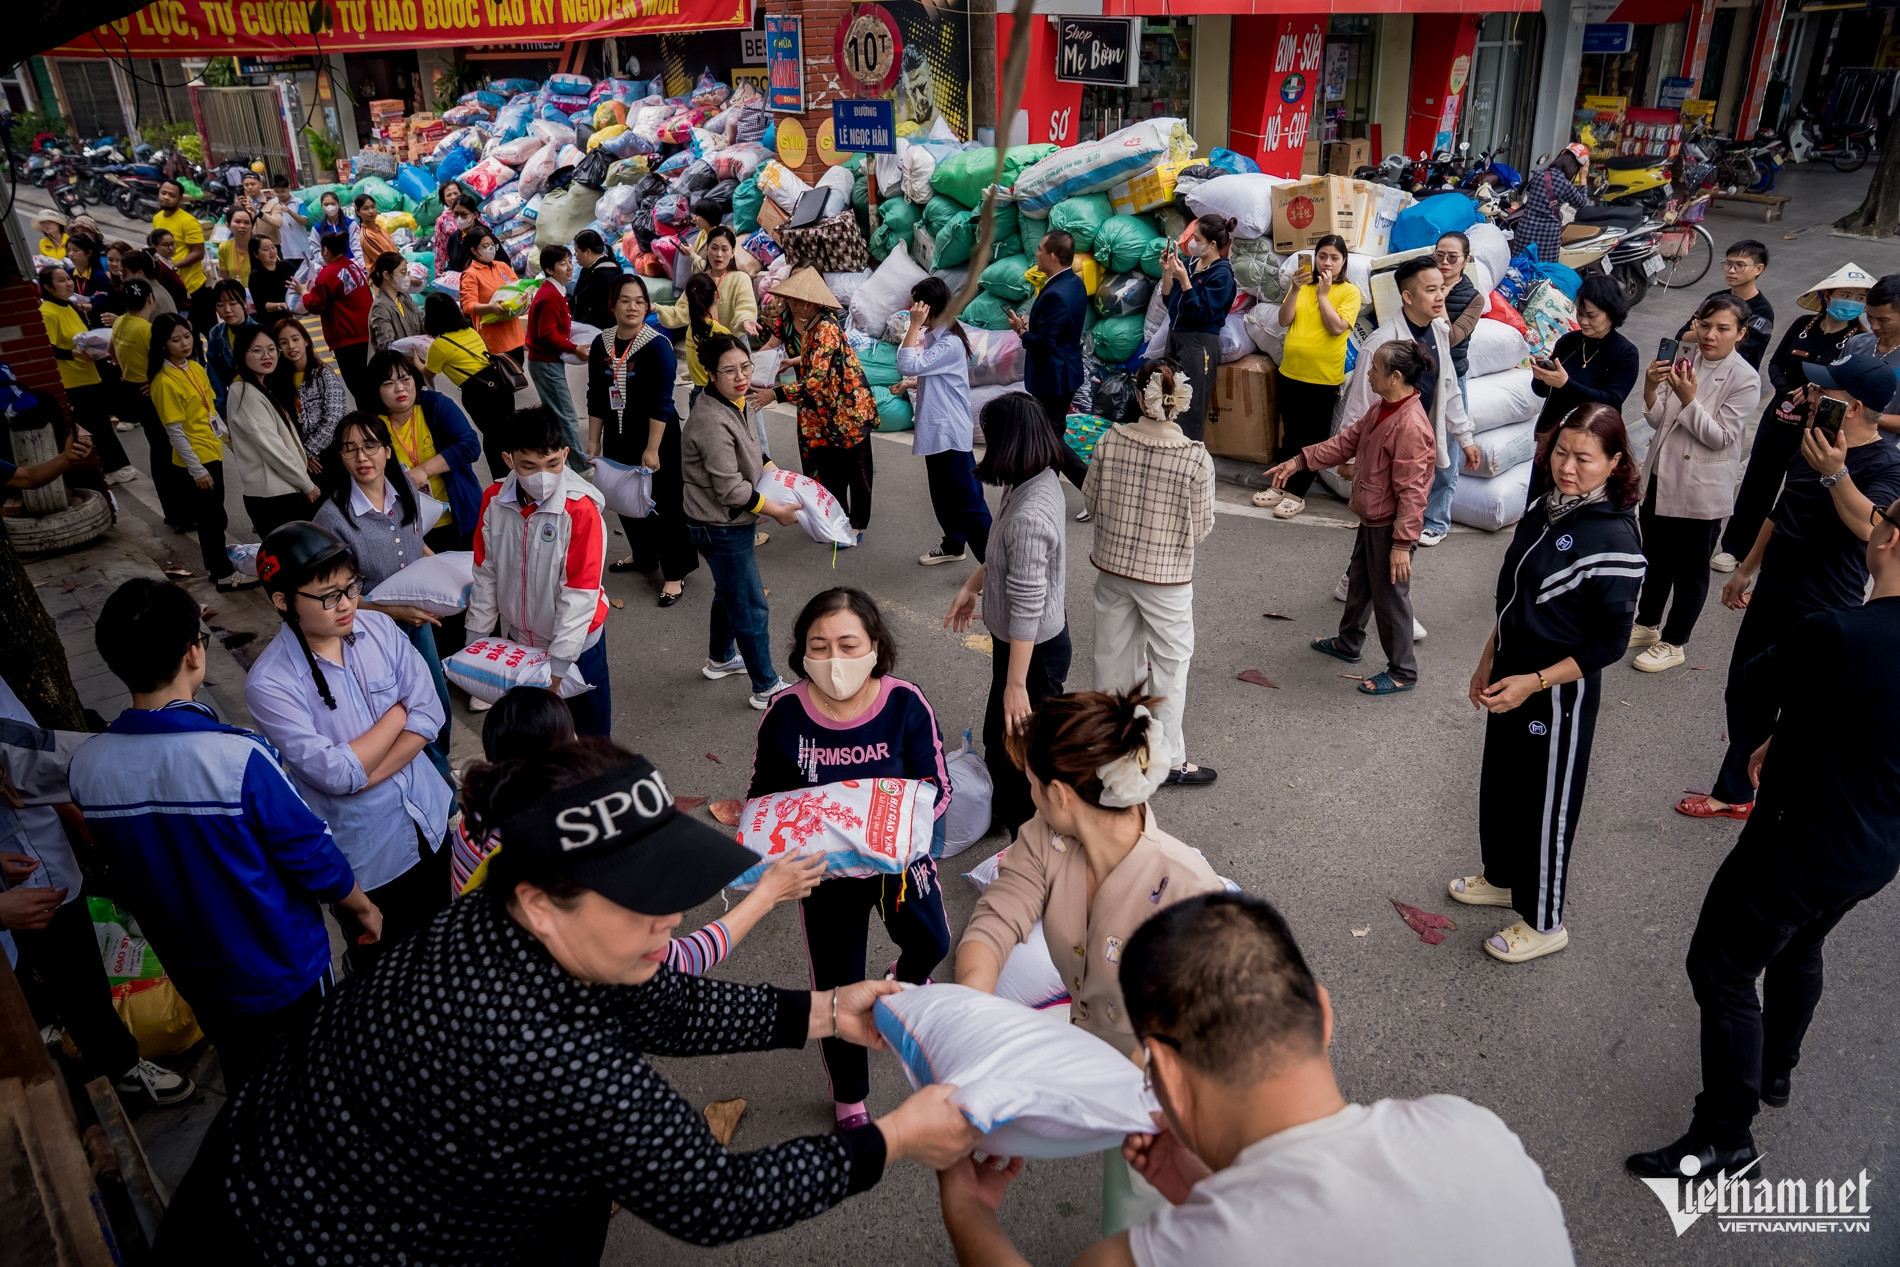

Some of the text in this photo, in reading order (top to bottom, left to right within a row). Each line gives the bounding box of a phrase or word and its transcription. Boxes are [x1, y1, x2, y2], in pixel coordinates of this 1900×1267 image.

[1065, 24, 1092, 44] Shop
[1064, 40, 1124, 76] Mẹ Bờm
[854, 104, 877, 117] ĐƯỜNG
[779, 135, 805, 150] GYM
[839, 125, 848, 145] LÊ
[849, 128, 870, 149] NGỌC
[872, 125, 888, 146] HÂN
